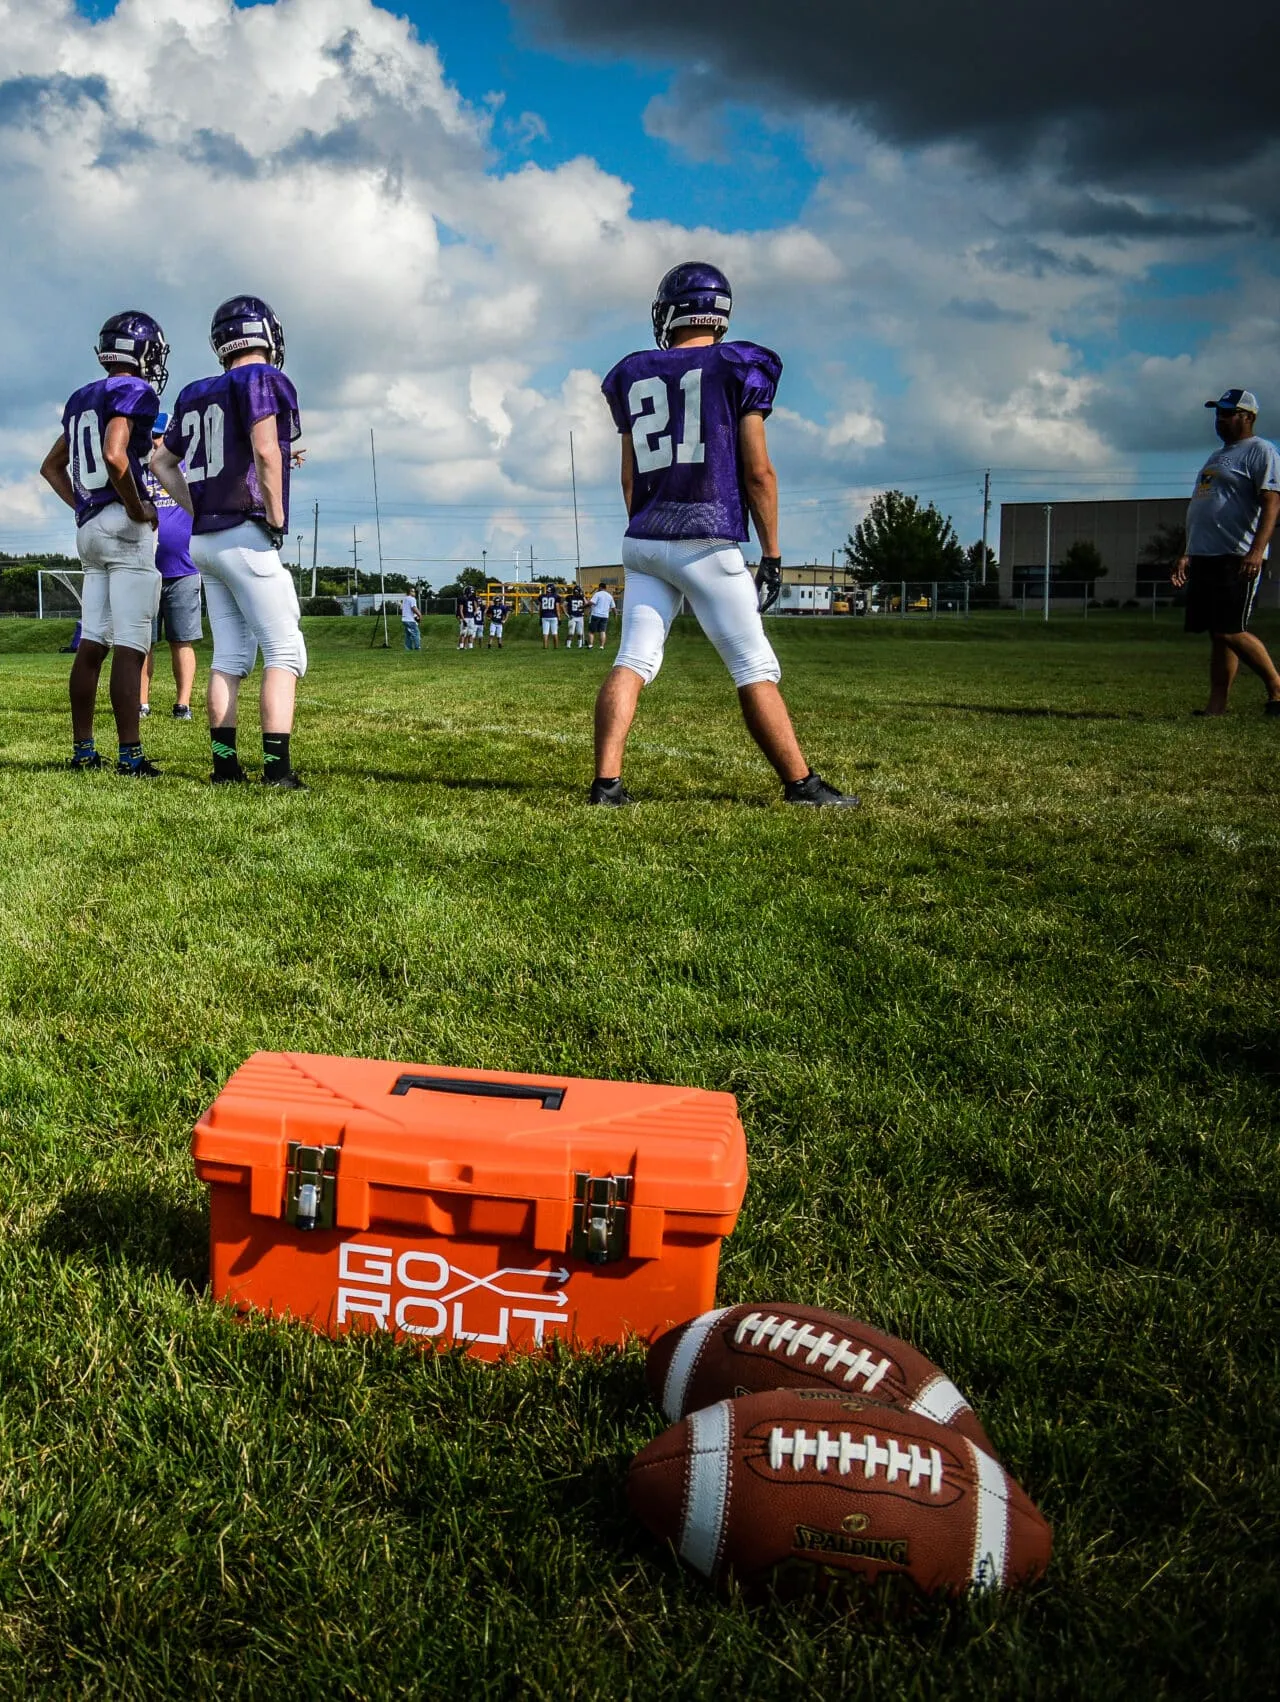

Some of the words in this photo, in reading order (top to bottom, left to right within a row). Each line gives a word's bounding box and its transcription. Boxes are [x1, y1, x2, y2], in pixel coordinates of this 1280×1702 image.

[689, 316, 723, 326] Riddell
[221, 338, 249, 353] Riddell
[181, 403, 225, 484] 20
[628, 368, 705, 473] 21
[541, 597, 555, 610] 20
[338, 1242, 450, 1292] GO
[336, 1286, 569, 1349] ROUT
[791, 1523, 908, 1567] SPALDING
